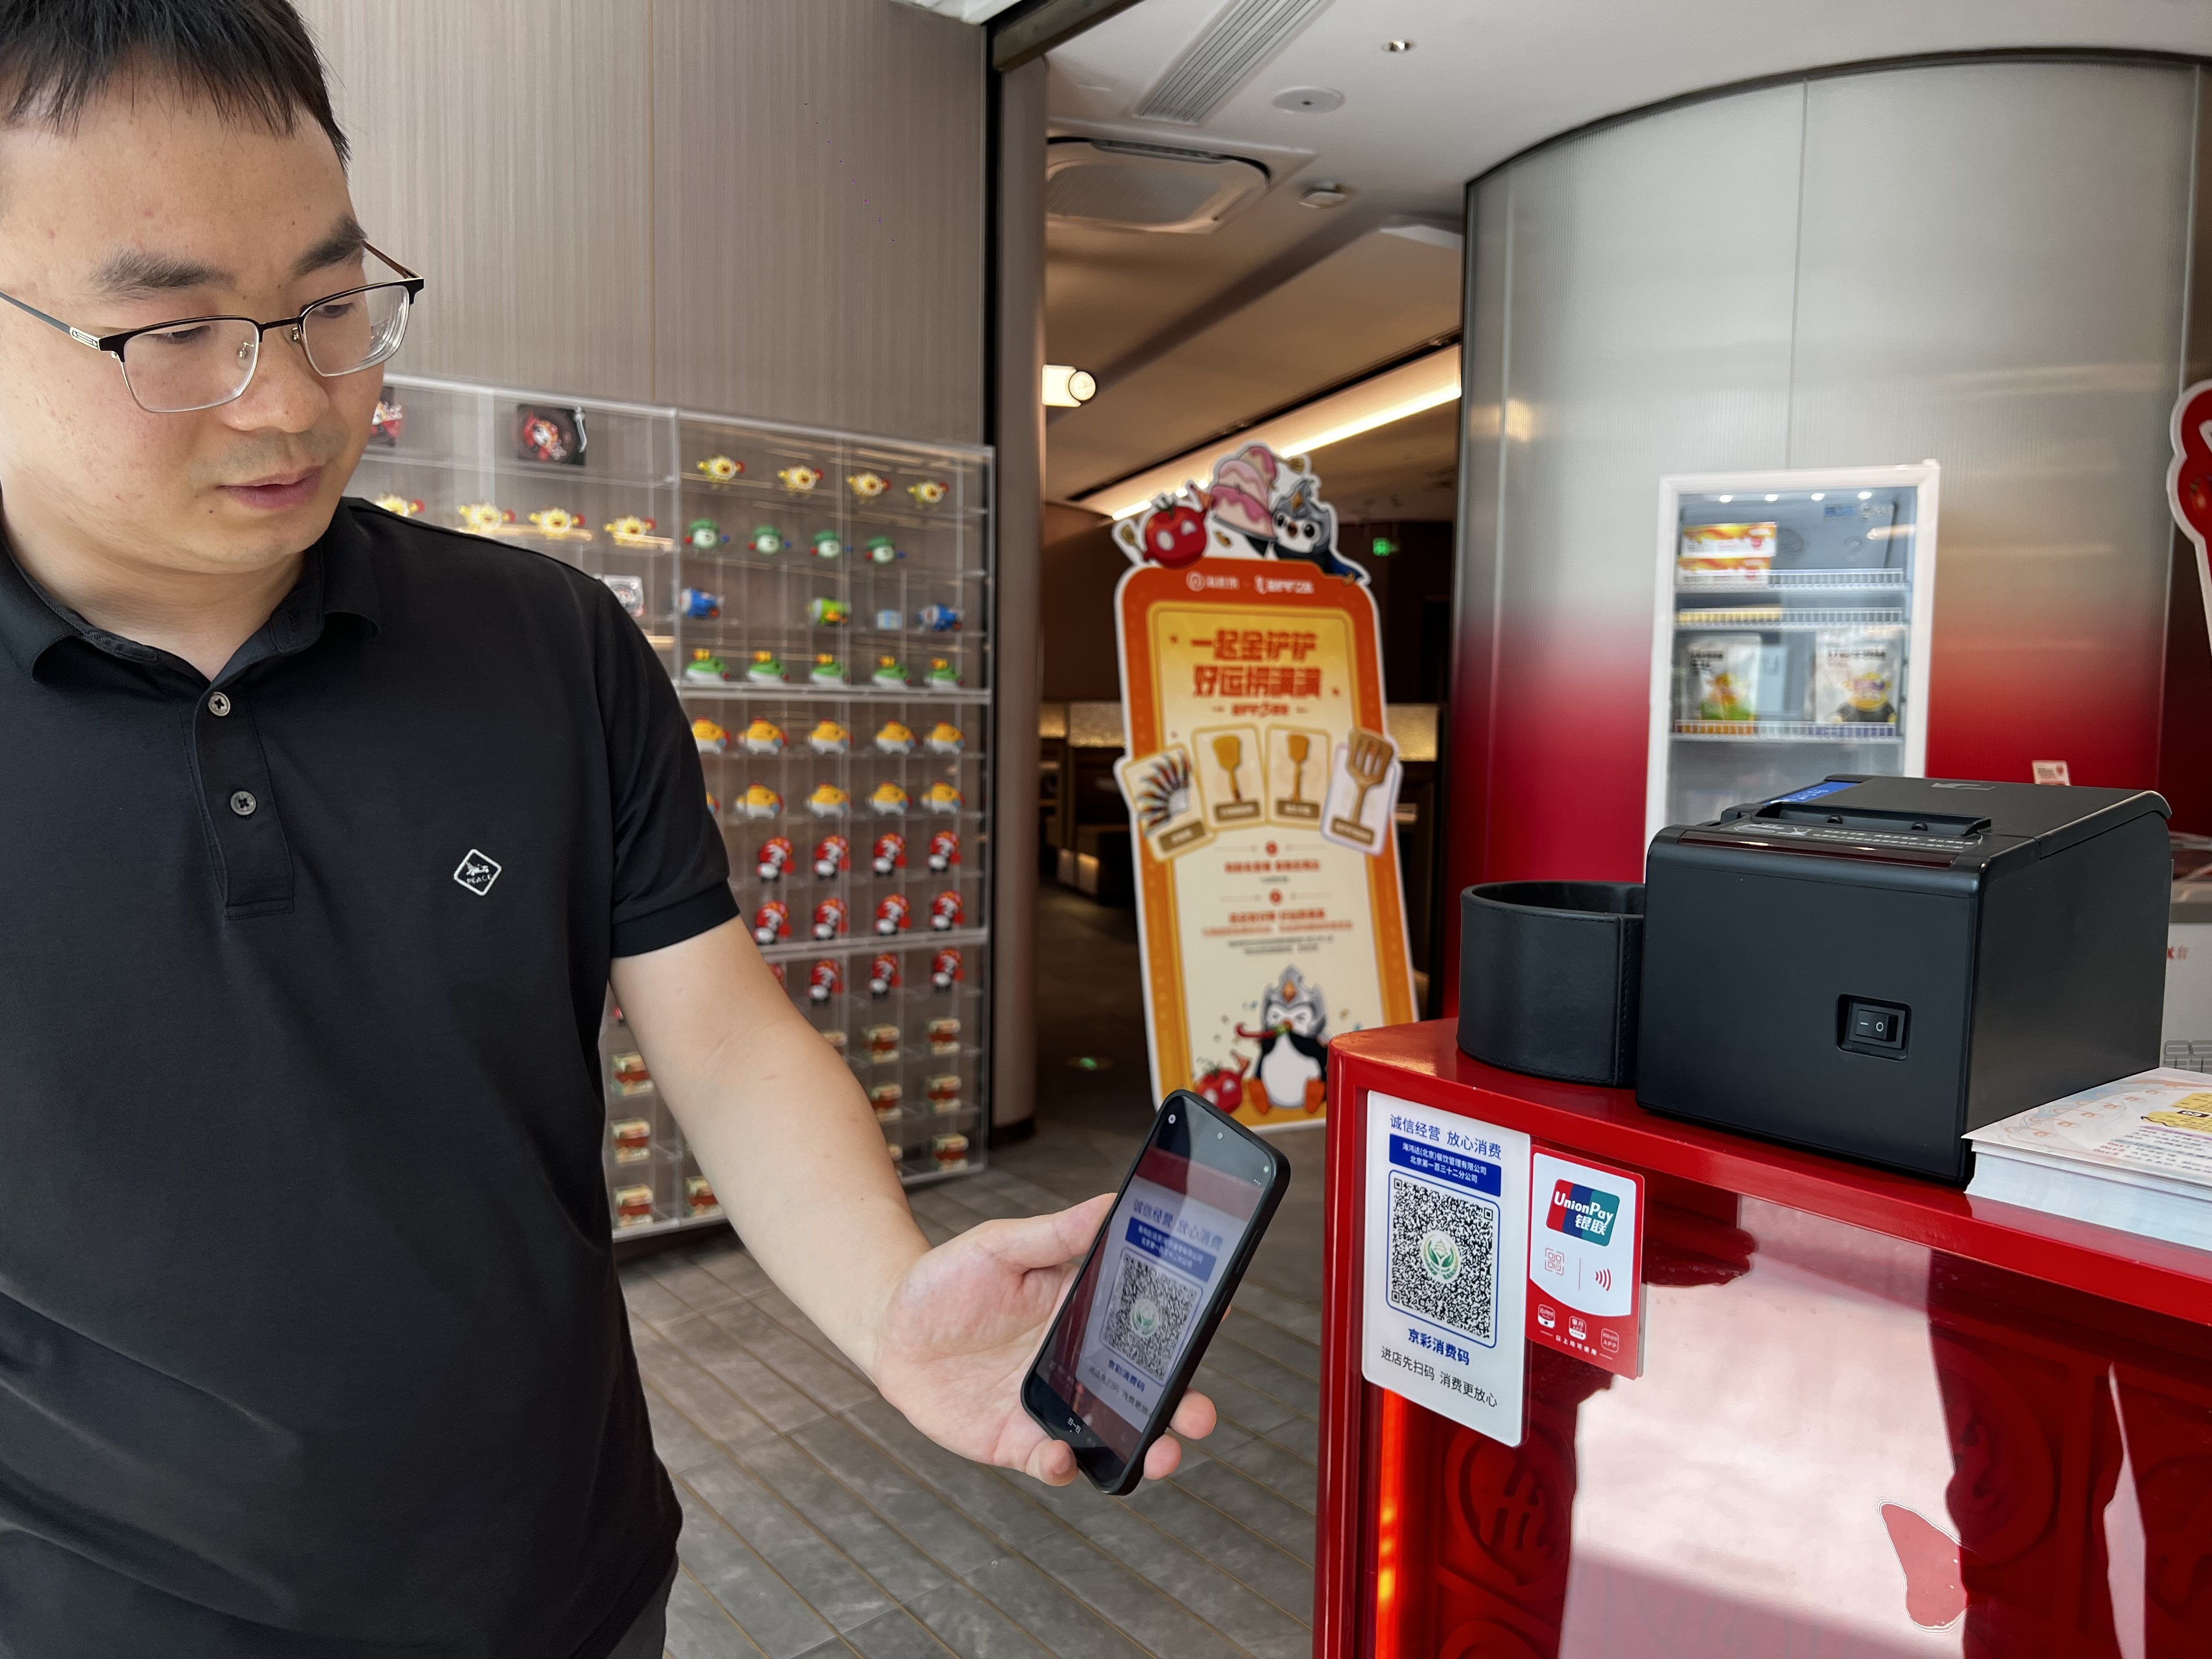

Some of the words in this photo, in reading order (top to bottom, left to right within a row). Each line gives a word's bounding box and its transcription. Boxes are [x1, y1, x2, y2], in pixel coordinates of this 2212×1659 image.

[1390, 1114, 1440, 1141] 诚信经营
[1447, 1130, 1501, 1159] 放心消费
[1410, 1155, 1477, 1183] 北京第一百三十二分公司
[1554, 1191, 1613, 1226] UnionPay
[1575, 1214, 1607, 1235] 银联
[1408, 1328, 1469, 1365] 京彩消费码
[1603, 1340, 1617, 1348] APP
[1381, 1346, 1435, 1380] 进店先扫码
[1440, 1371, 1497, 1407] 消费更放心
